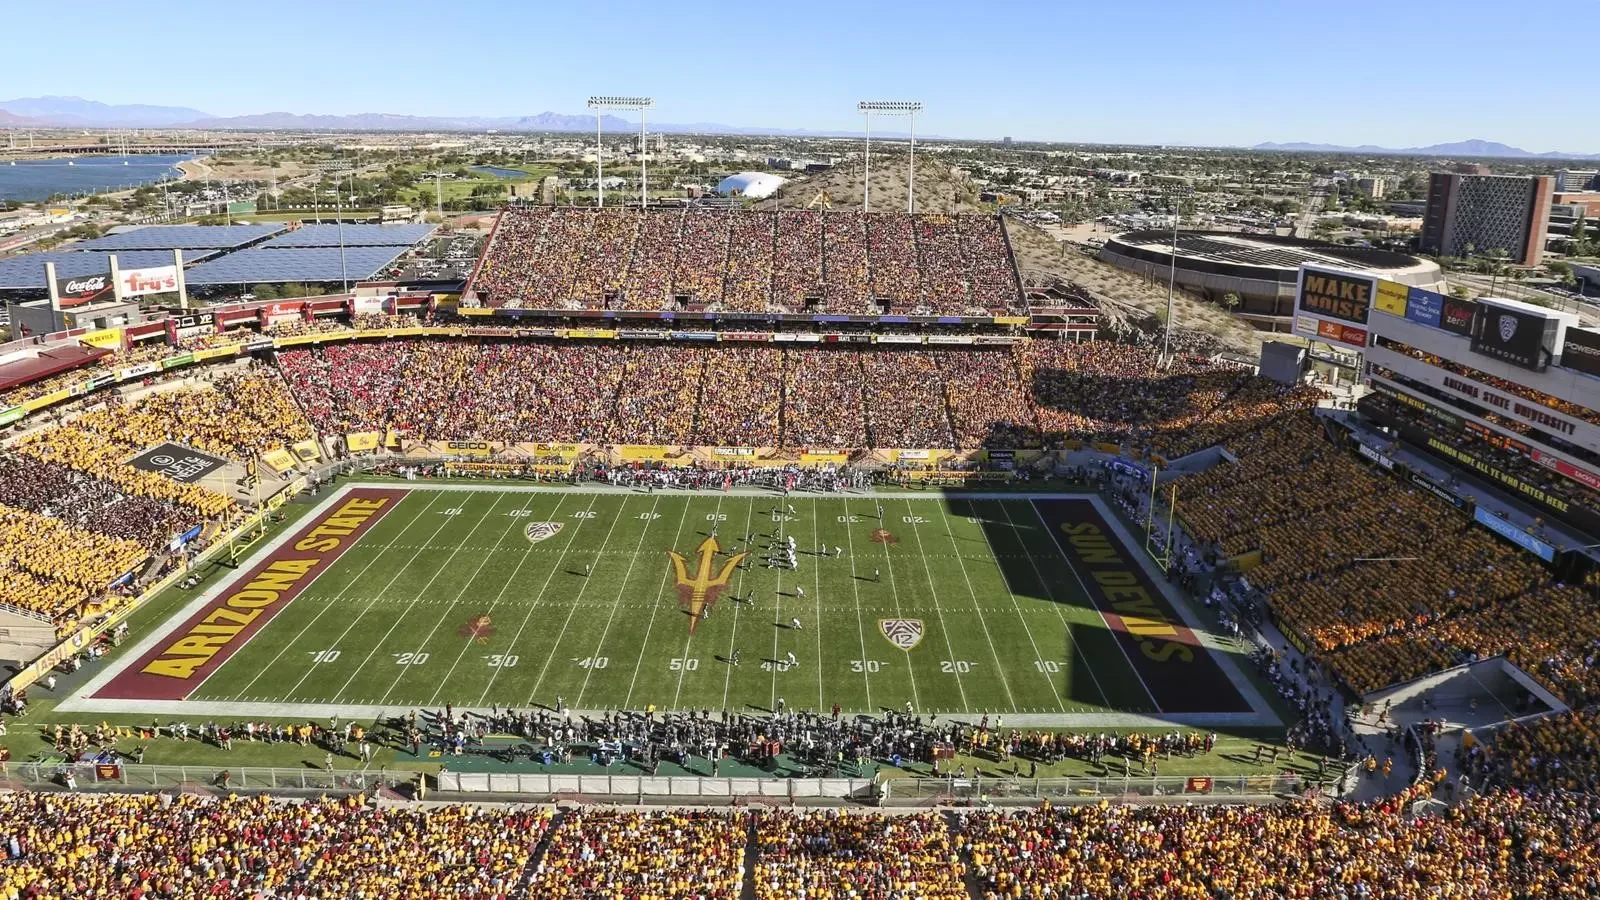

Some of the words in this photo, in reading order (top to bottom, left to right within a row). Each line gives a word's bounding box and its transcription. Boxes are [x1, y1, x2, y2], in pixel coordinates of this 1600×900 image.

[66, 277, 105, 294] Coca-Cola
[124, 272, 175, 292] fry's
[1305, 275, 1369, 303] MAKE
[1305, 294, 1366, 320] NOISE
[1447, 315, 1466, 327] zero
[1443, 376, 1478, 399] ARIZONA
[1482, 391, 1510, 411] STATE
[1514, 403, 1576, 436] UNIVERSITY
[448, 442, 487, 450] GEICO
[1359, 443, 1379, 461] MUSCLE
[1379, 454, 1395, 470] MILK
[1428, 438, 1457, 457] ABANDON
[1457, 451, 1475, 467] HOPE
[1475, 461, 1488, 474] ALL
[1490, 467, 1500, 479] YE
[1500, 472, 1519, 488] WHO
[1519, 482, 1545, 501] ENTER
[1546, 495, 1569, 513] HERE
[443, 508, 464, 516] 10
[509, 509, 533, 517] 20
[574, 511, 597, 519] 30
[639, 512, 662, 520] 40
[706, 513, 728, 522] 50
[771, 514, 791, 522] 40
[837, 515, 858, 523] 30
[902, 516, 924, 524] 20
[1060, 522, 1125, 564] SUN
[140, 559, 321, 680] ARIZONA
[294, 497, 392, 552] STATE
[1091, 570, 1195, 663] DEVILS
[895, 634, 914, 645] 12
[311, 650, 342, 663] 10
[396, 652, 430, 666] 20
[487, 654, 520, 668] 30
[577, 656, 609, 669] 40
[669, 658, 700, 671] 50
[760, 660, 791, 673] 40
[850, 660, 880, 673] 30
[940, 660, 970, 673] 20
[1033, 660, 1060, 673] 10
